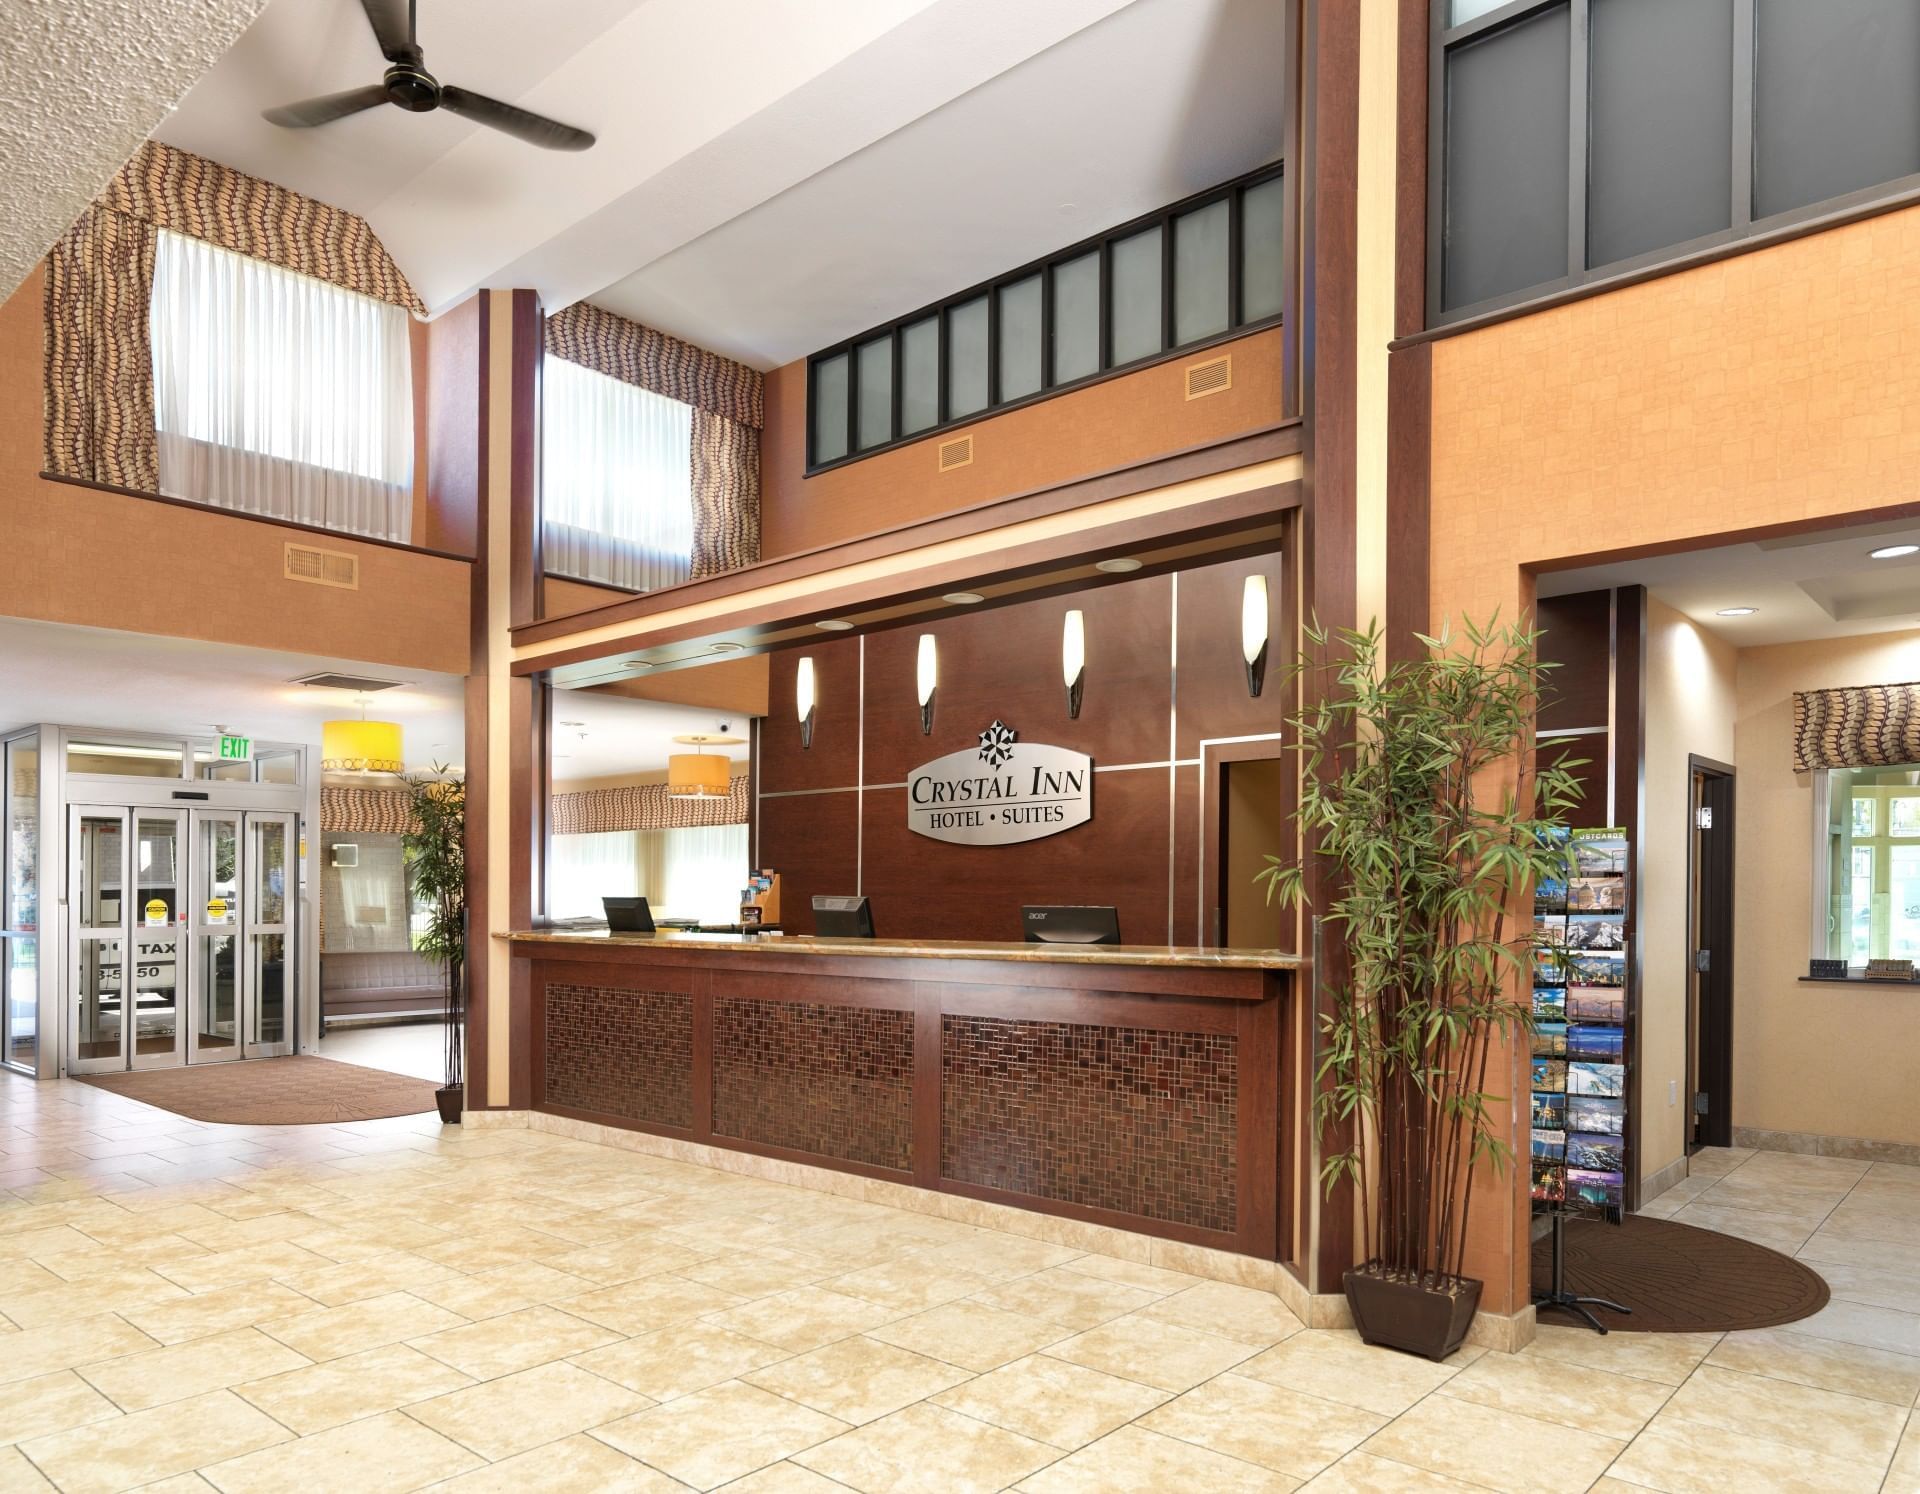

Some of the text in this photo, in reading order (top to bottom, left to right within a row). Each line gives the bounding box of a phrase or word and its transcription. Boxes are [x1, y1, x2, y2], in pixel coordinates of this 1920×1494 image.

[220, 736, 250, 759] EXIT
[911, 765, 1085, 804] CRYSTAL INN
[930, 805, 1065, 829] HOTEL SUITES
[1028, 912, 1048, 920] acer
